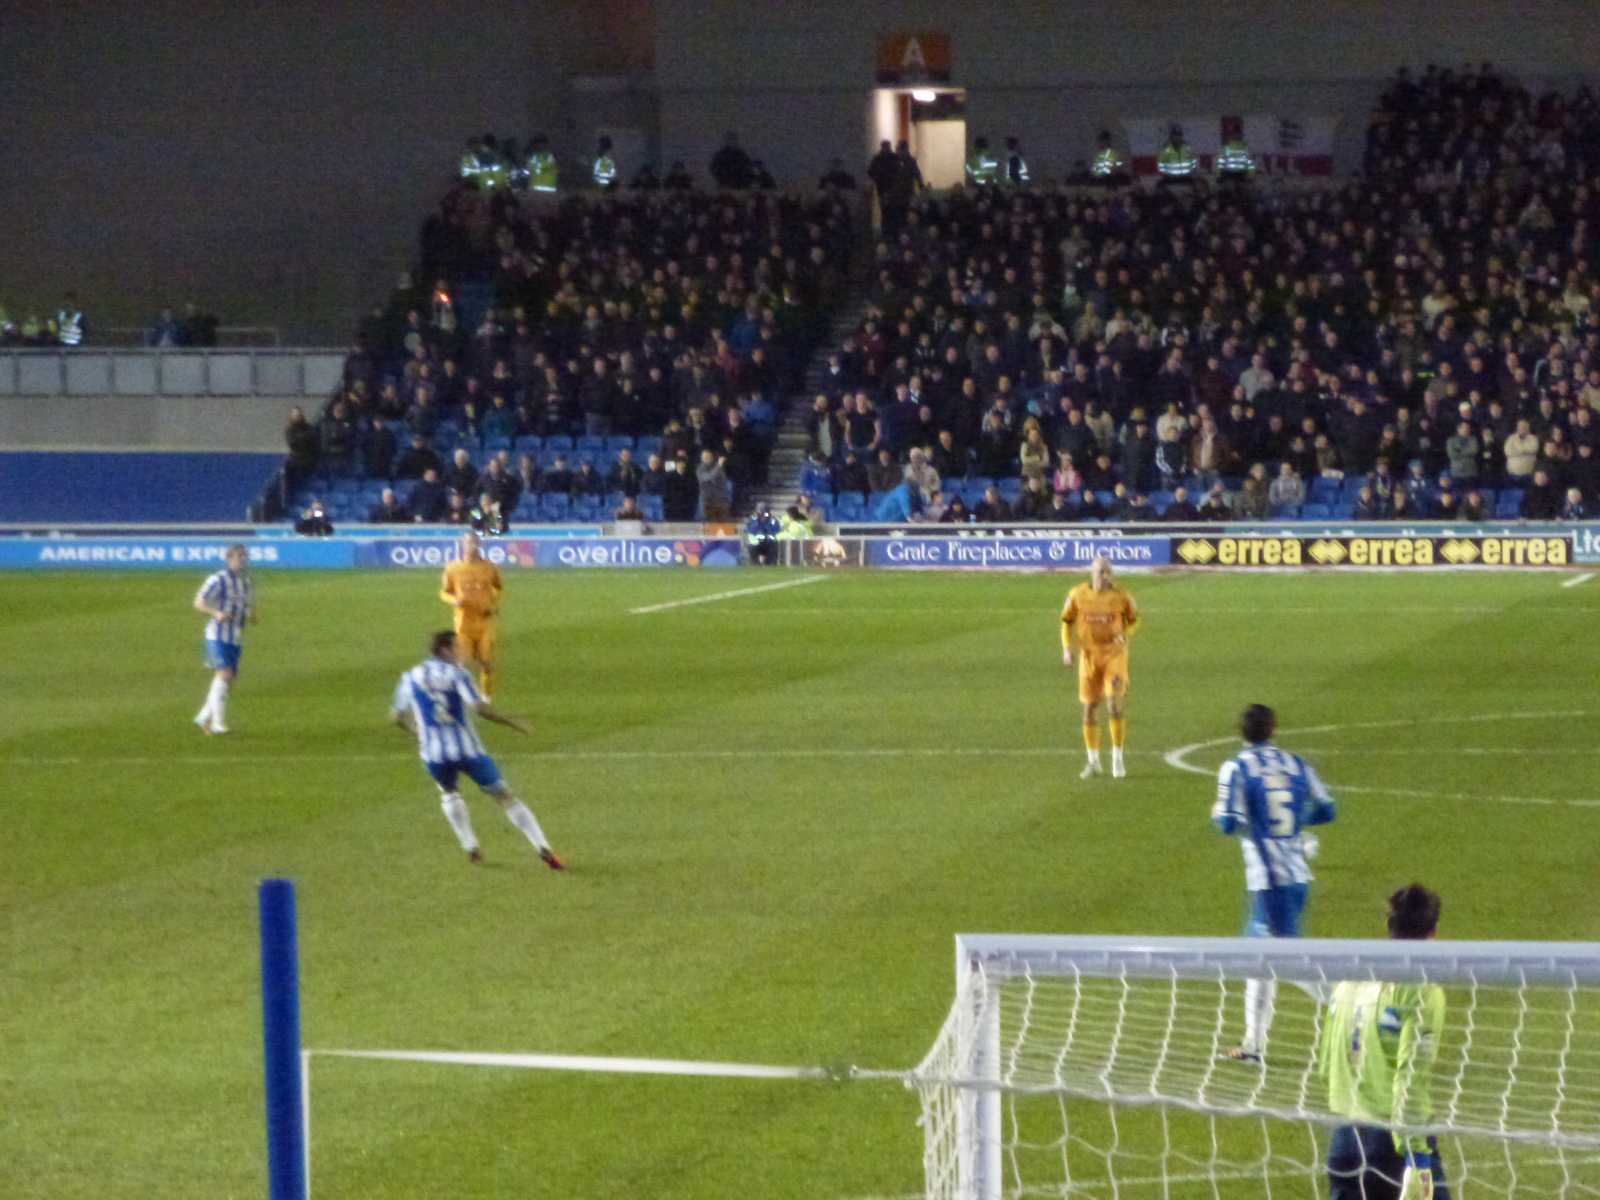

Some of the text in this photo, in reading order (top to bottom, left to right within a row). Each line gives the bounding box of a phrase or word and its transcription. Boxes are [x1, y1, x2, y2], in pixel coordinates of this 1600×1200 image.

[901, 37, 927, 68] A
[40, 547, 165, 561] AMERICAN
[391, 540, 506, 564] overle
[558, 540, 672, 564] overline
[886, 541, 1152, 566] Grate Fireplaces & Interiors
[1217, 538, 1567, 565] errea errea errea
[1265, 789, 1296, 837] 5
